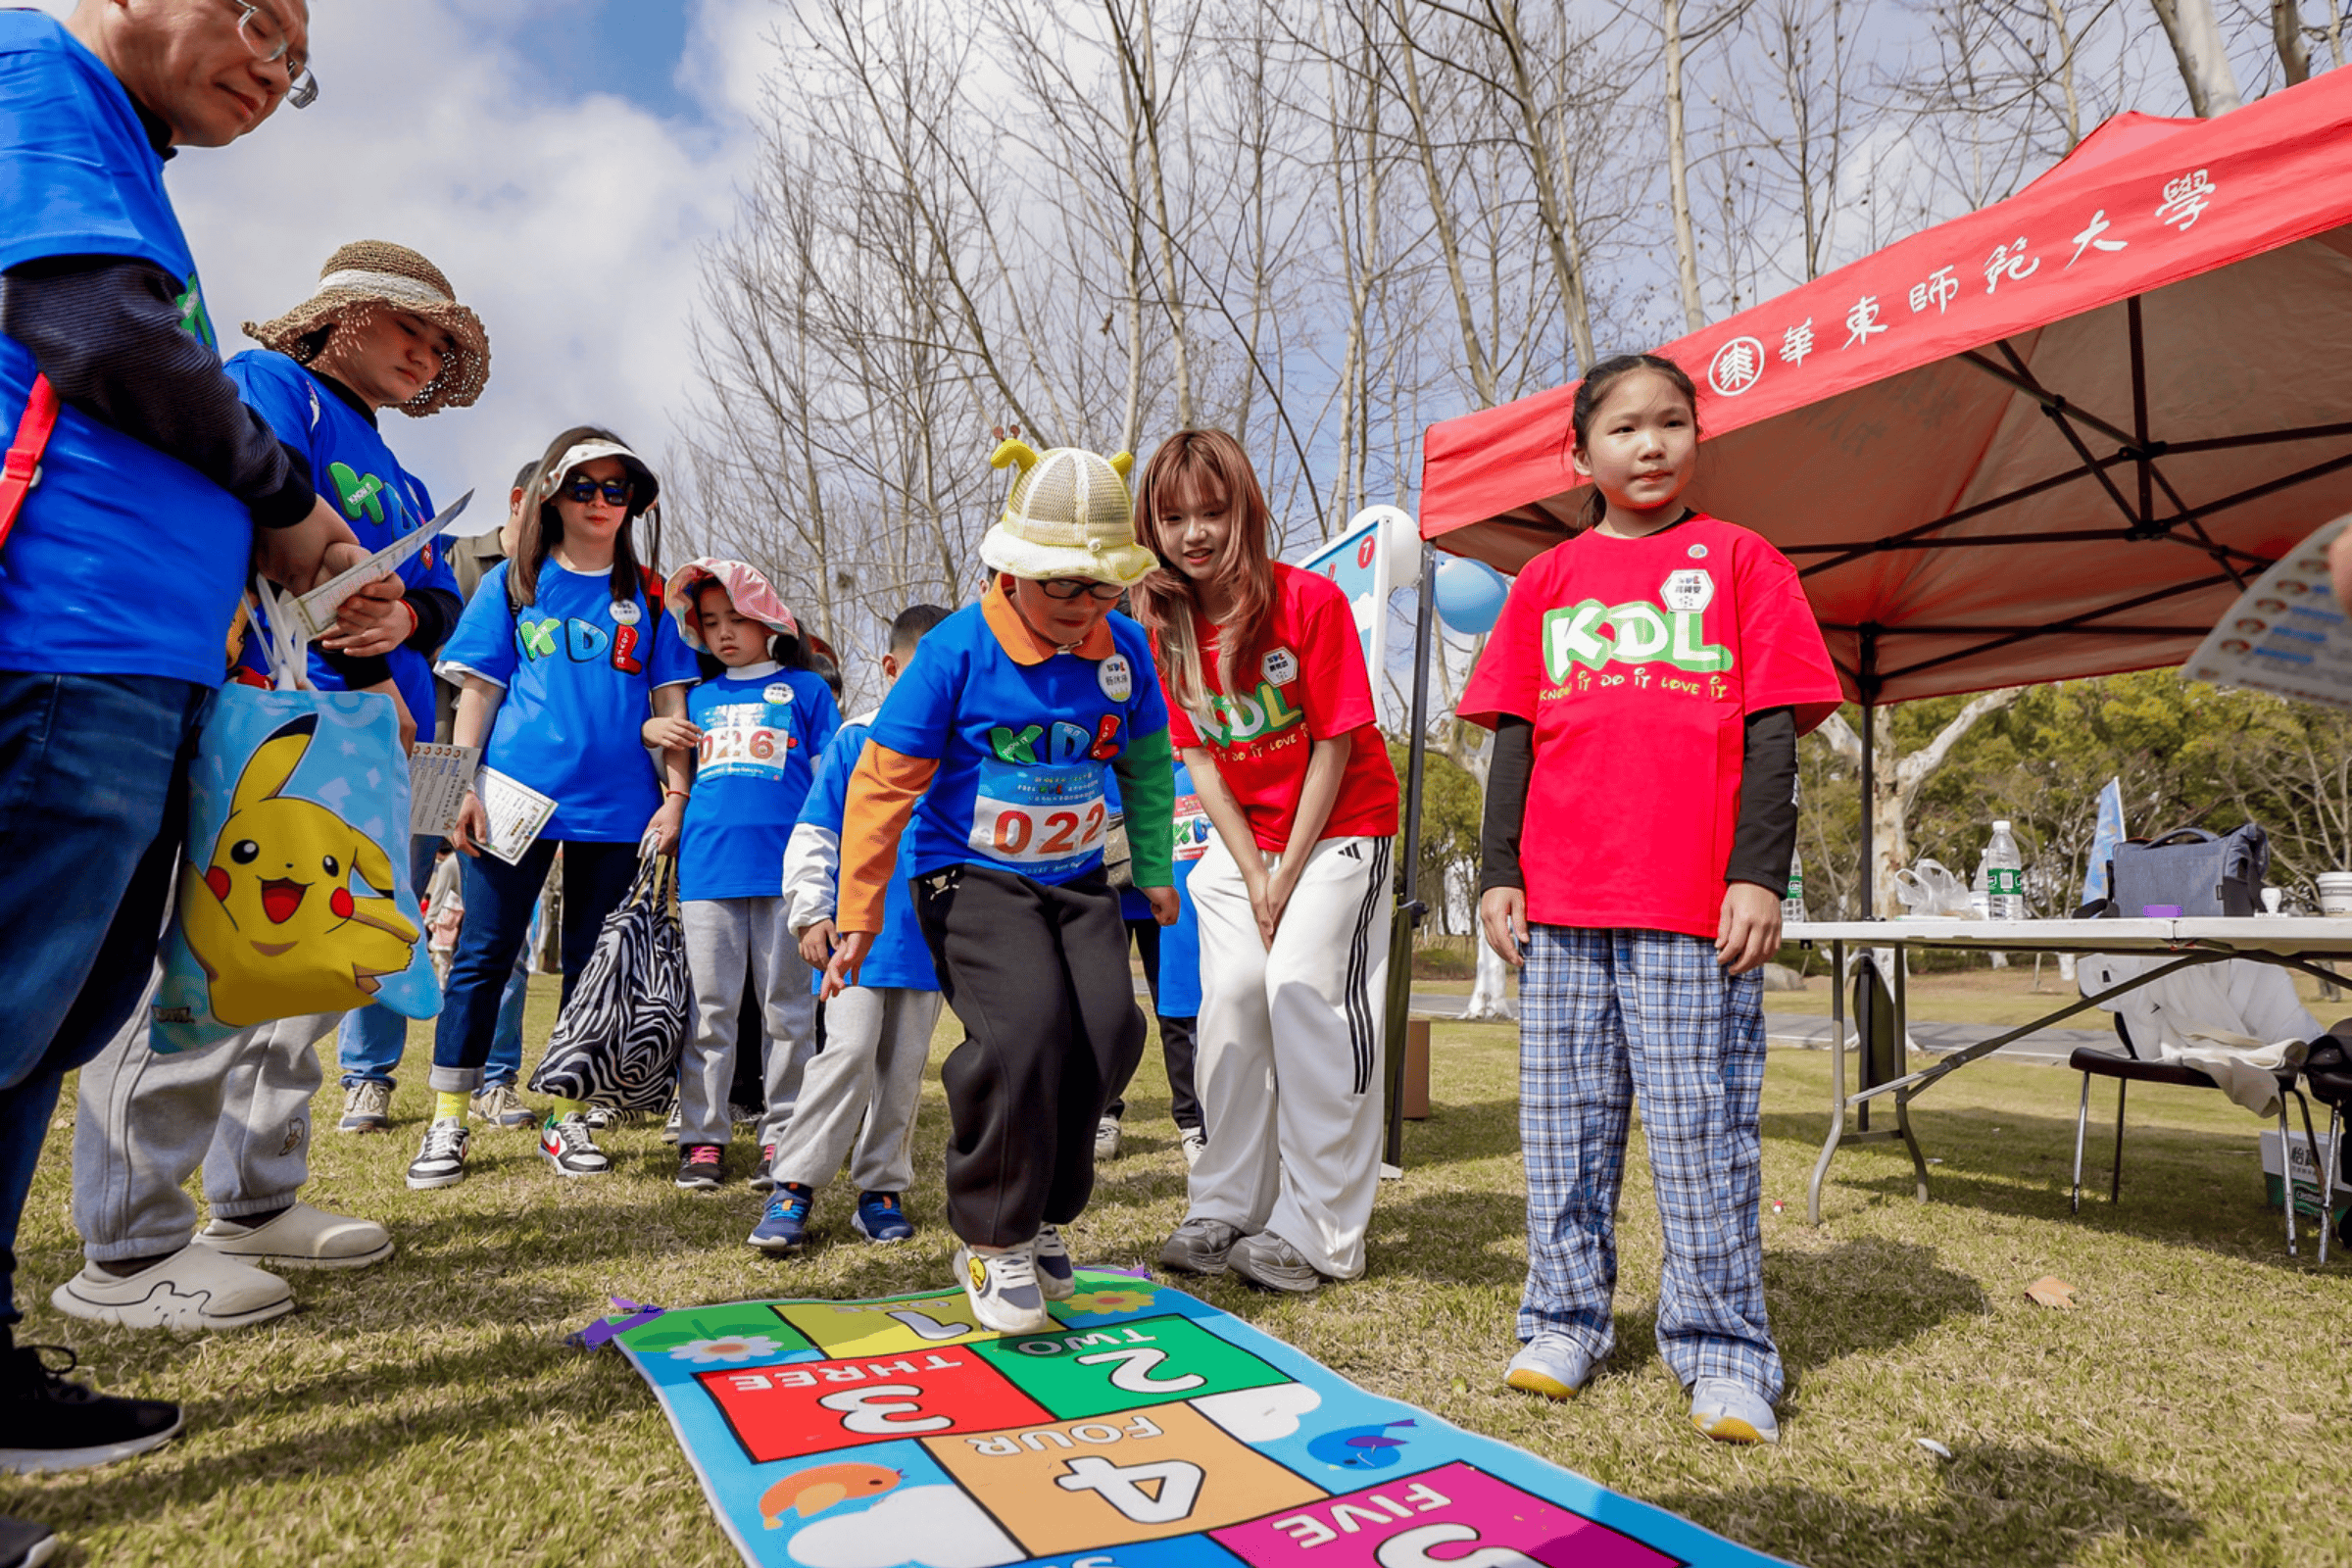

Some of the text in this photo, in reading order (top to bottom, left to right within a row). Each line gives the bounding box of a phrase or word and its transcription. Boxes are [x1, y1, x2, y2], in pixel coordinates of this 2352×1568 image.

[1779, 169, 2217, 368] 華東師範大學
[1363, 540, 1372, 563] 1
[519, 617, 643, 675] KDL
[1544, 600, 1731, 684] KDL
[1577, 670, 1592, 692] IT
[1599, 673, 1626, 687] DO
[1634, 667, 1651, 689] IT
[1660, 676, 1701, 696] LOVE
[1709, 675, 1728, 700] IT
[699, 729, 775, 765] 026
[990, 714, 1121, 765] KDL
[1268, 733, 1298, 752] LOVE
[994, 802, 1105, 856] 022
[885, 1309, 973, 1341] 1
[1017, 1328, 1157, 1356] TWO
[727, 1354, 963, 1392] THREE
[1073, 1347, 1208, 1395] 2
[816, 1383, 956, 1435] 3
[964, 1414, 1165, 1457] FOUR
[1053, 1455, 1207, 1525] 4
[1270, 1483, 1452, 1550] FIVE
